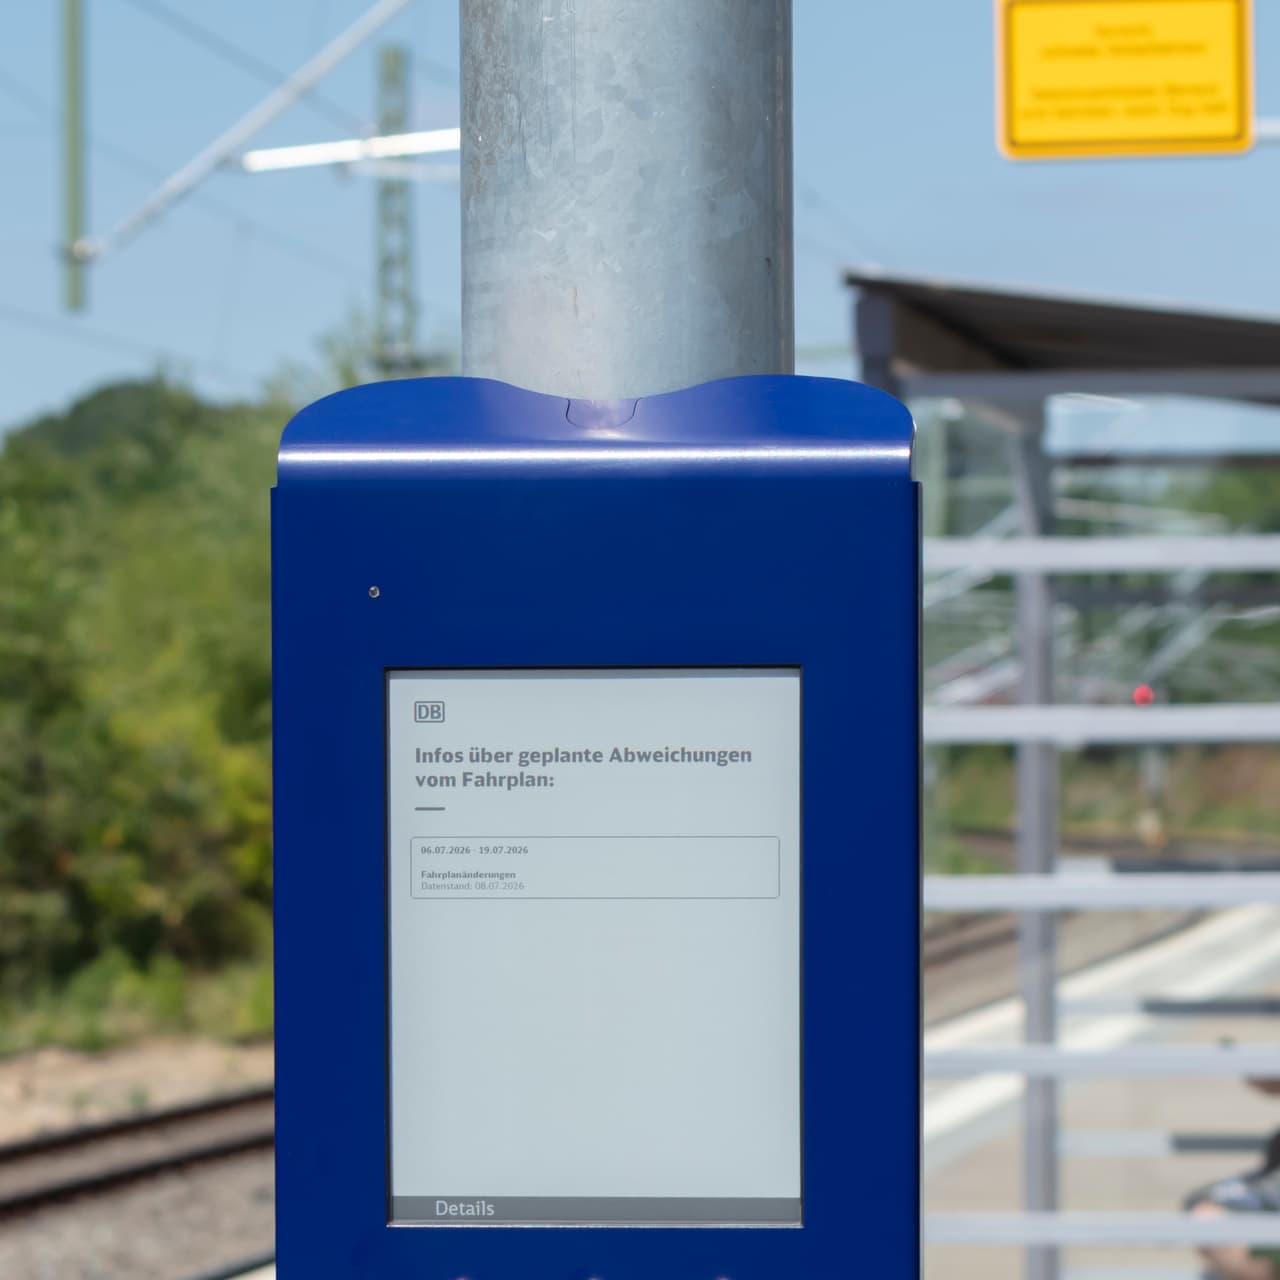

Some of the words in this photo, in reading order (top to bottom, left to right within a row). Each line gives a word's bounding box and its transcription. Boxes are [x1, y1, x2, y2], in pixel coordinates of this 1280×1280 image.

[416, 703, 443, 721] DB
[416, 747, 463, 763] Infos
[469, 747, 513, 763] über
[518, 747, 603, 767] geplante
[609, 746, 752, 766] Abweichungen
[415, 775, 457, 788] vom
[462, 771, 554, 791] Fahrplan:
[479, 845, 529, 855] 19.07.2026
[421, 870, 516, 880] Fahrplanänderungen
[421, 881, 473, 891] Datenstand:
[435, 1199, 495, 1217] Details
